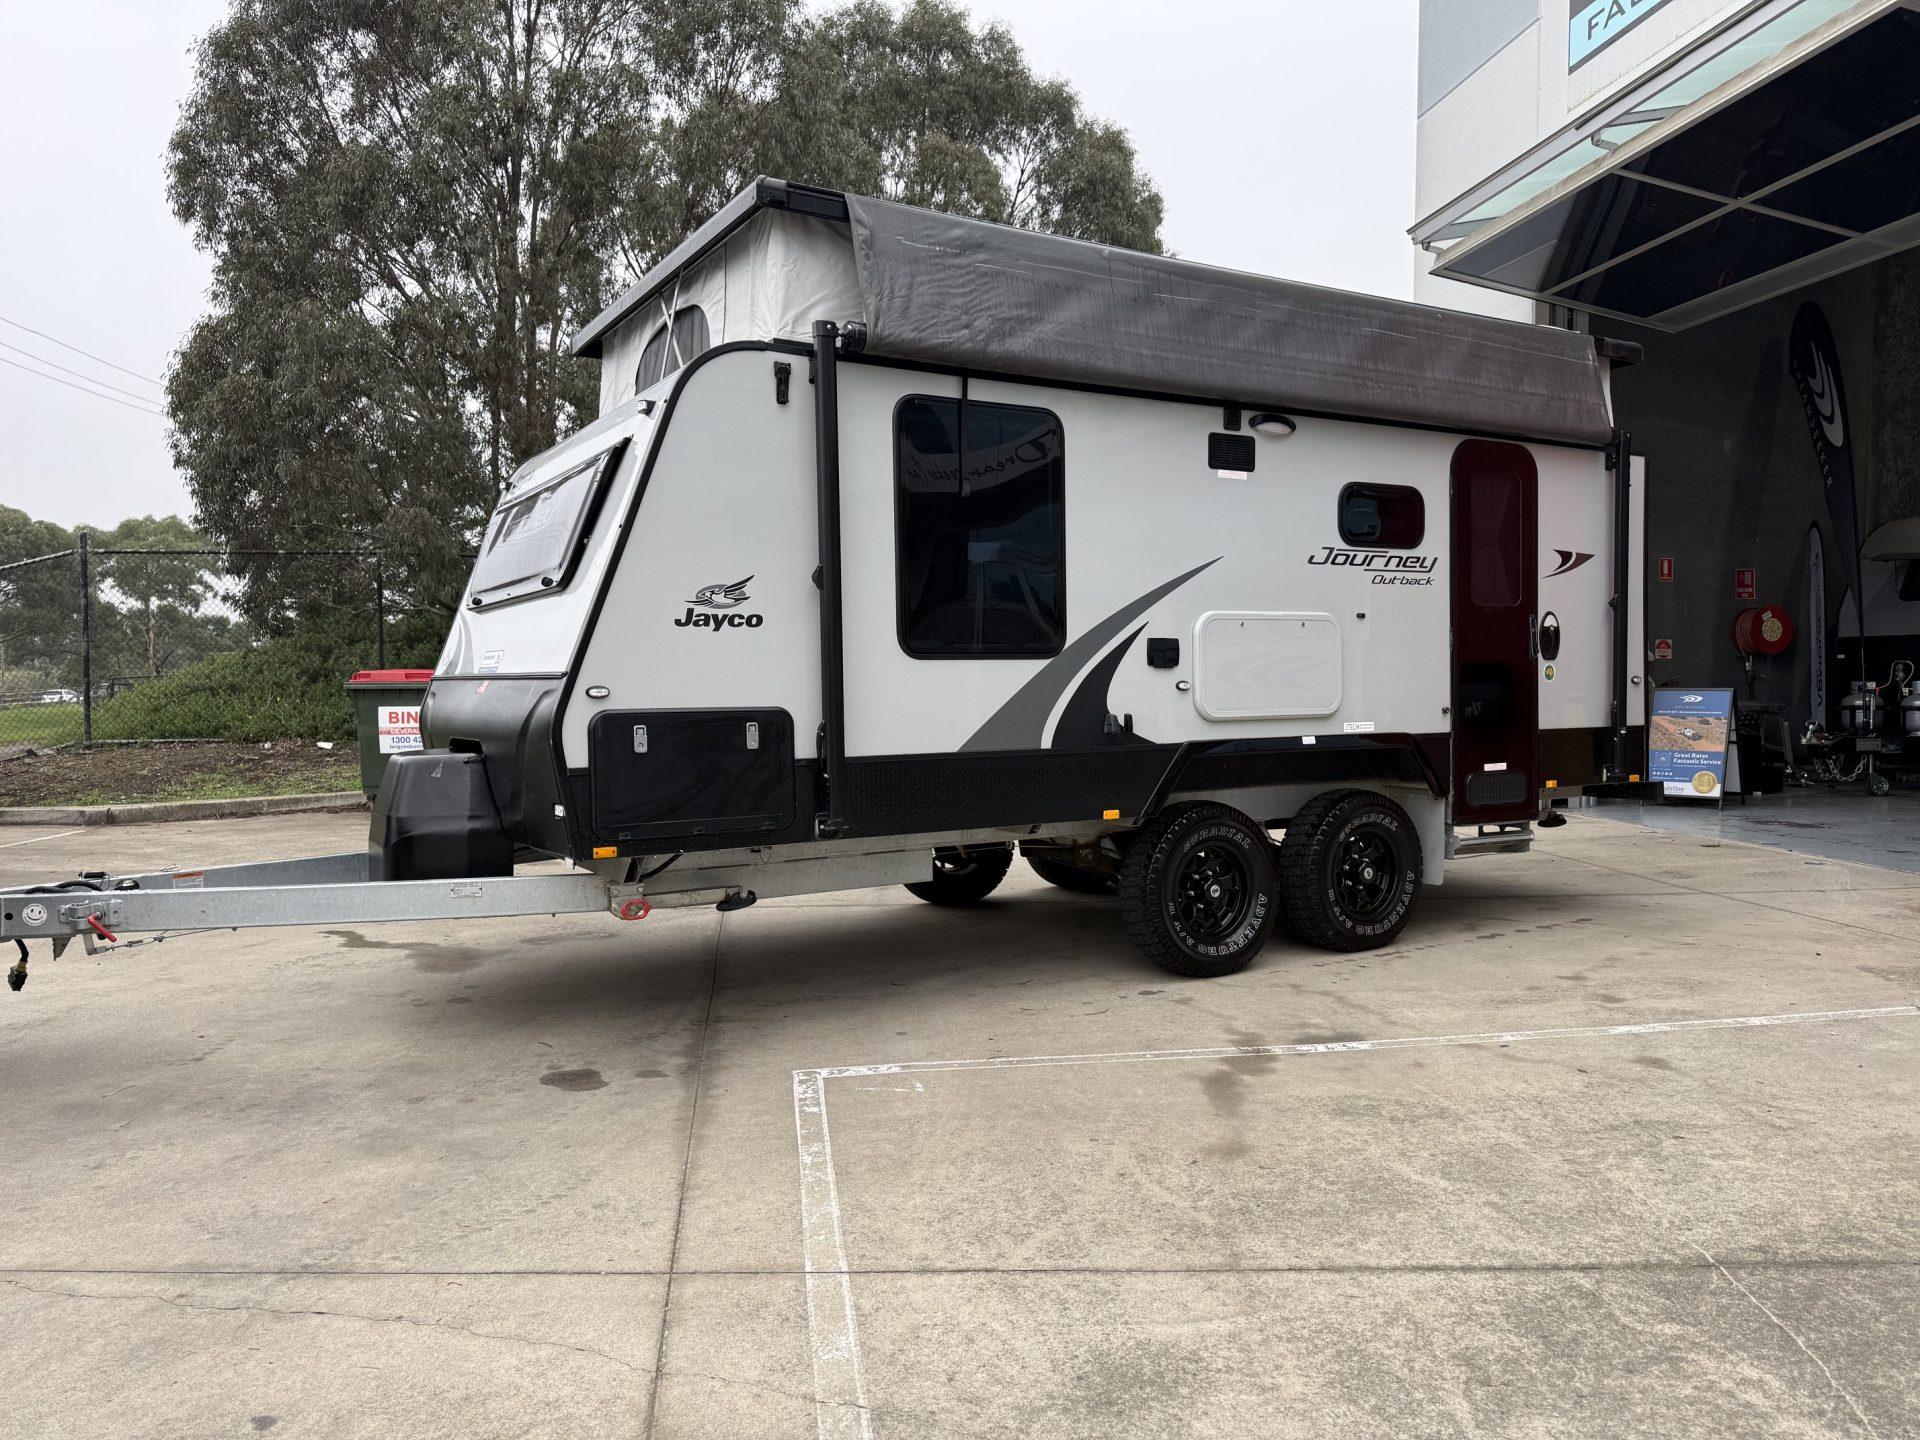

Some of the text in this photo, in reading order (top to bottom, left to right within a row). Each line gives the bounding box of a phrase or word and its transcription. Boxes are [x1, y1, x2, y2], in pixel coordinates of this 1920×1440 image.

[1587, 0, 1643, 41] FA
[1307, 546, 1438, 573] Journey
[1371, 574, 1434, 586] Outback
[674, 607, 764, 632] Jayco
[1197, 893, 1268, 956] ADVENTURO
